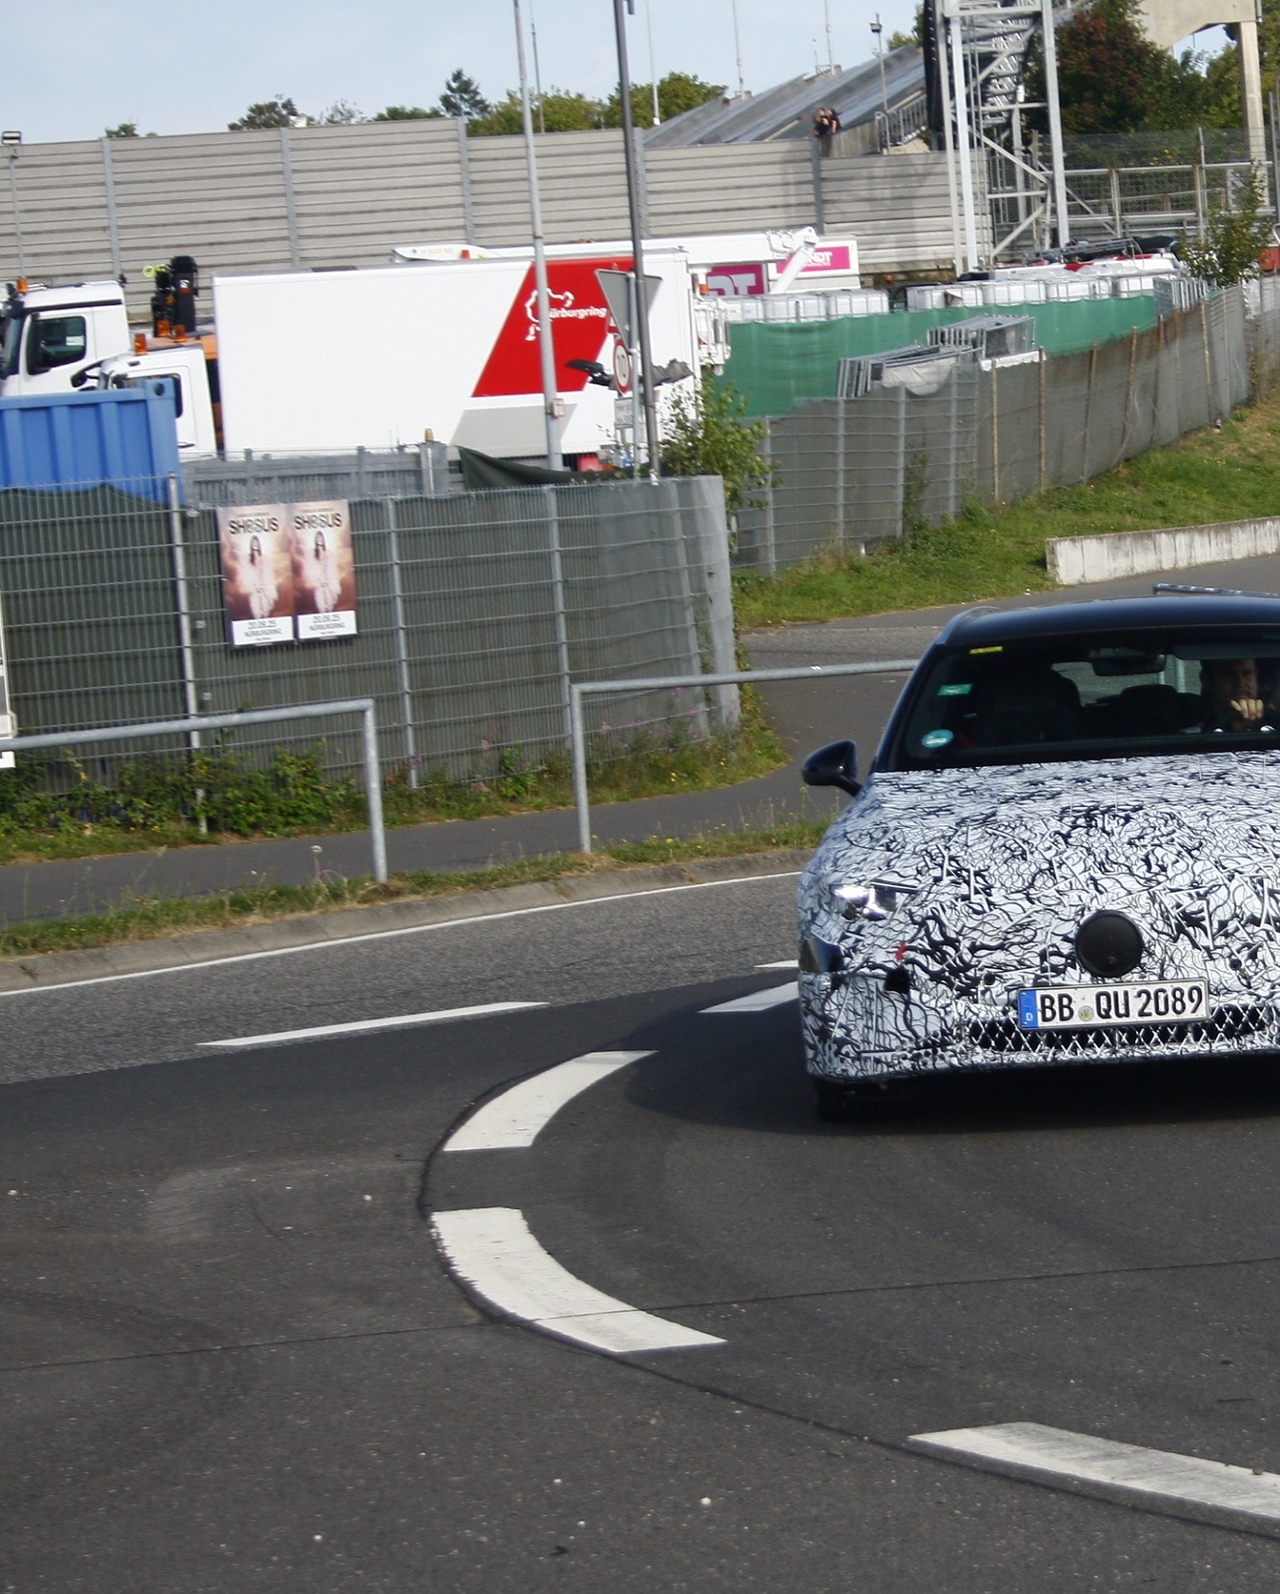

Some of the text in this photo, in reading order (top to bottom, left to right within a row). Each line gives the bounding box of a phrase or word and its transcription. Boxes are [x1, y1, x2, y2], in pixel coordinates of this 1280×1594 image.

[1041, 985, 1204, 1023] BB QU 2089
[1025, 1012, 1034, 1021] D
